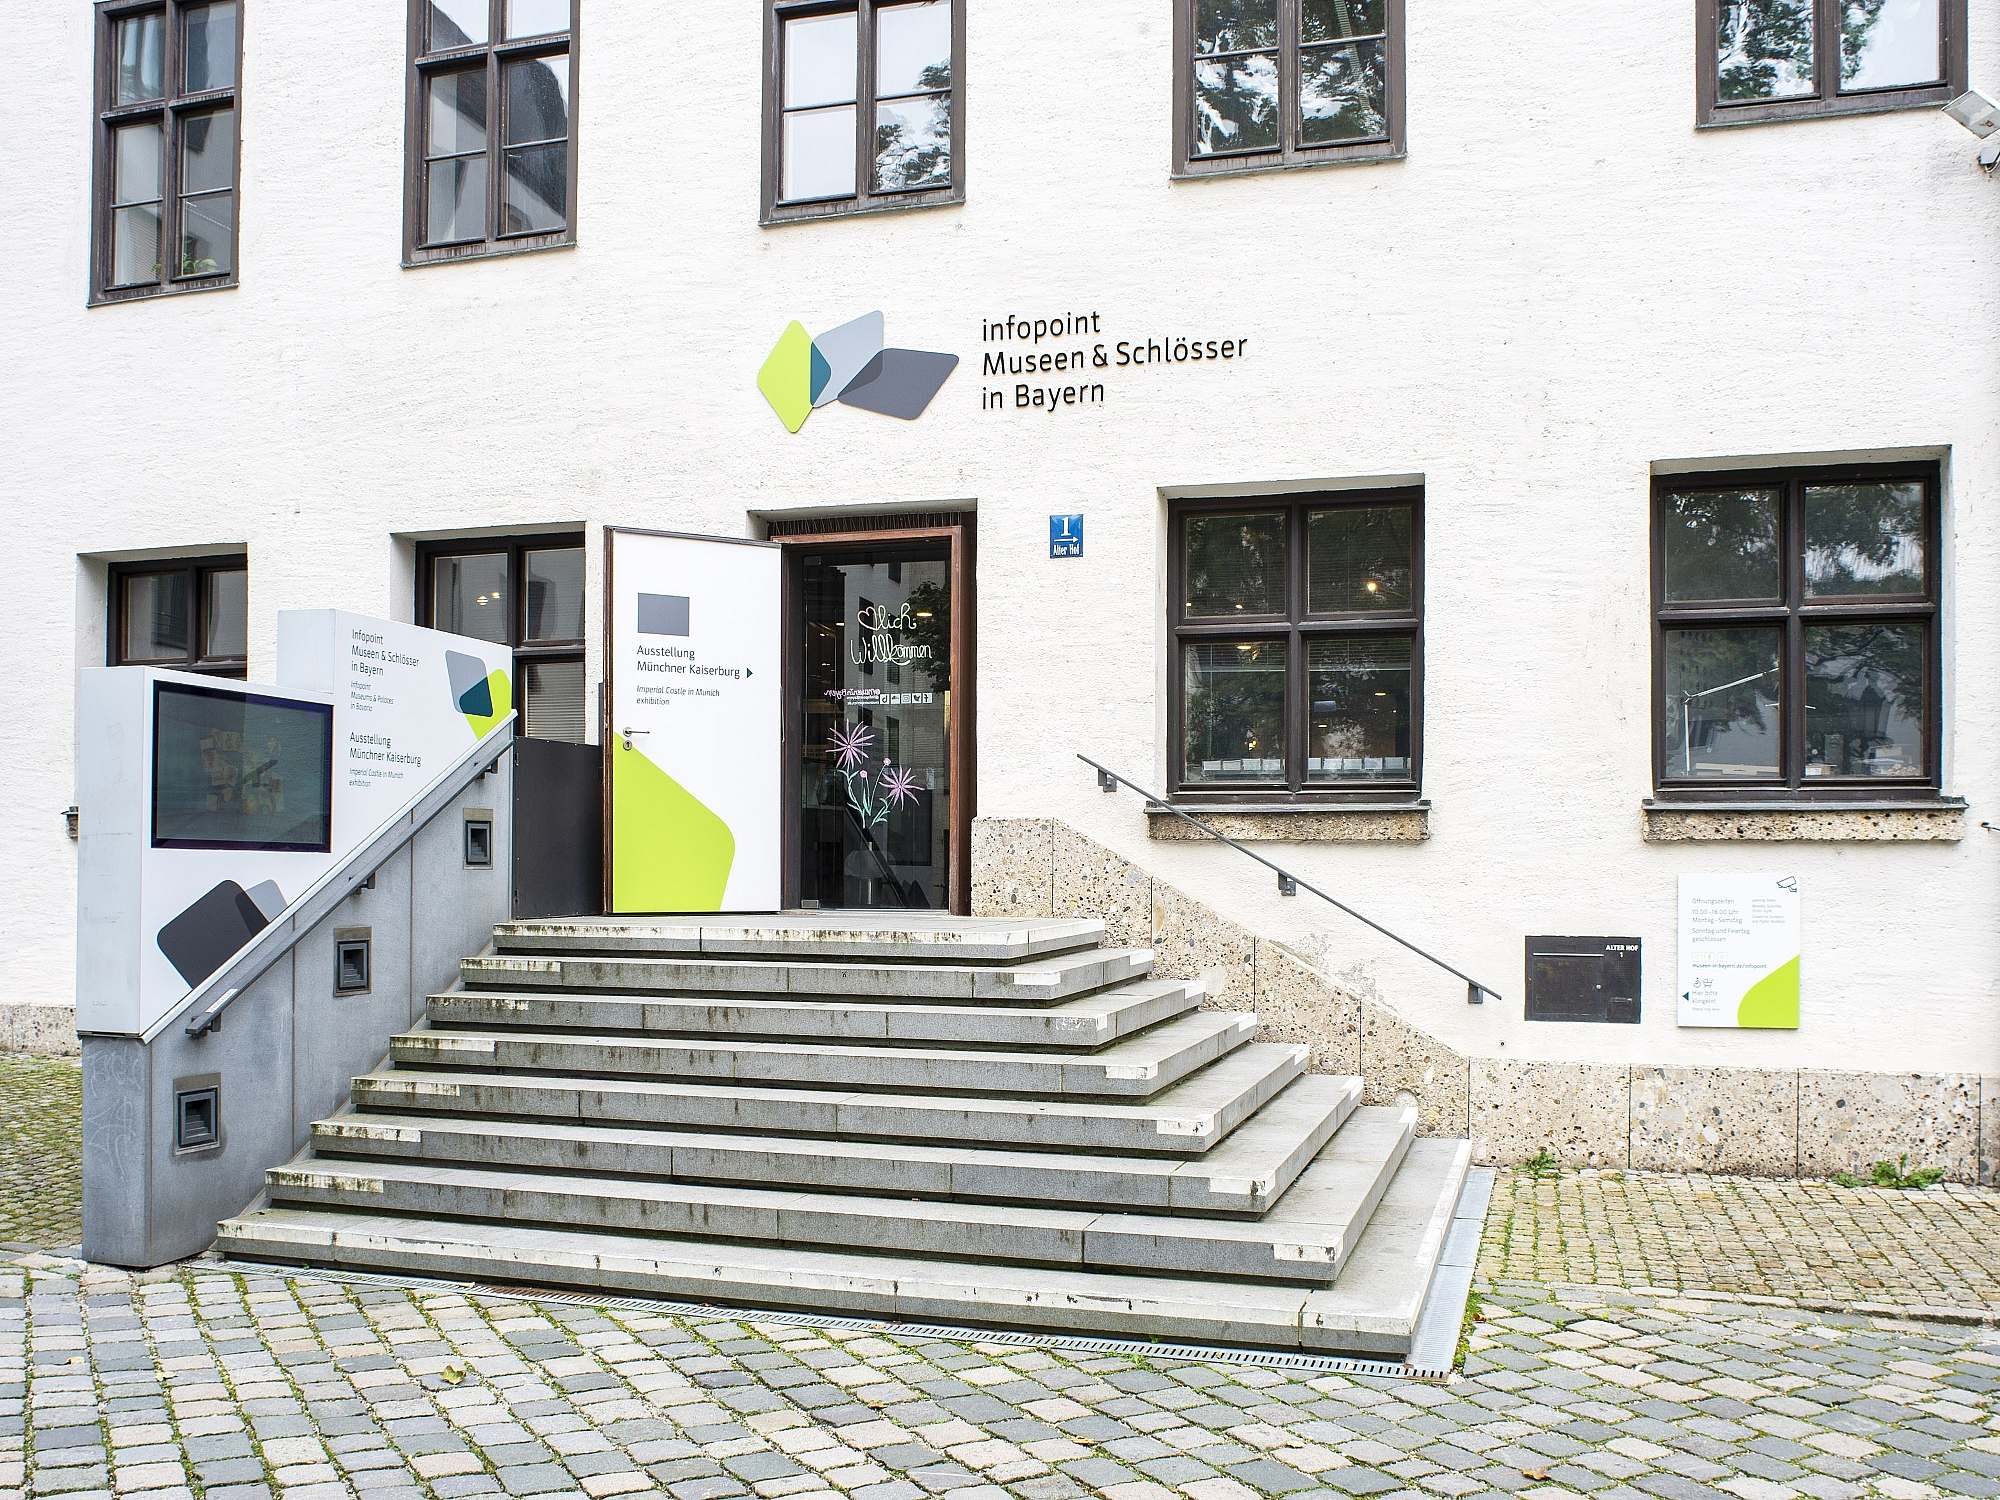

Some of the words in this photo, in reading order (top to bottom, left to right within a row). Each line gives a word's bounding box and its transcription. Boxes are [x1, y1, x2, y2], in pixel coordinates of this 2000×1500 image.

[982, 311, 1101, 344] infopoint
[983, 350, 1084, 376] Museen
[1092, 344, 1108, 367] &
[1116, 337, 1248, 366] Schlösser
[982, 387, 1003, 410] in
[1015, 383, 1104, 413] Bayern
[1061, 517, 1072, 536] 1
[1053, 544, 1068, 556] Alter
[352, 628, 384, 645] Infopoint
[351, 644, 380, 660] Museen
[381, 650, 387, 662] &
[387, 651, 420, 668] Schlösser
[636, 645, 696, 661] Ausstellung
[850, 633, 933, 666] Willkommen
[351, 660, 359, 672] in
[359, 662, 384, 677] Bayern
[636, 660, 687, 674] Münchner
[689, 664, 741, 680] Kaiserburg
[636, 684, 665, 695] Imperial
[666, 686, 687, 696] Castle
[688, 687, 695, 696] in
[695, 688, 720, 697] Munich
[636, 697, 671, 706] exhibition
[349, 731, 392, 749] Ausstellung
[349, 747, 385, 761] Münchner
[386, 751, 422, 768] Kaiserburg
